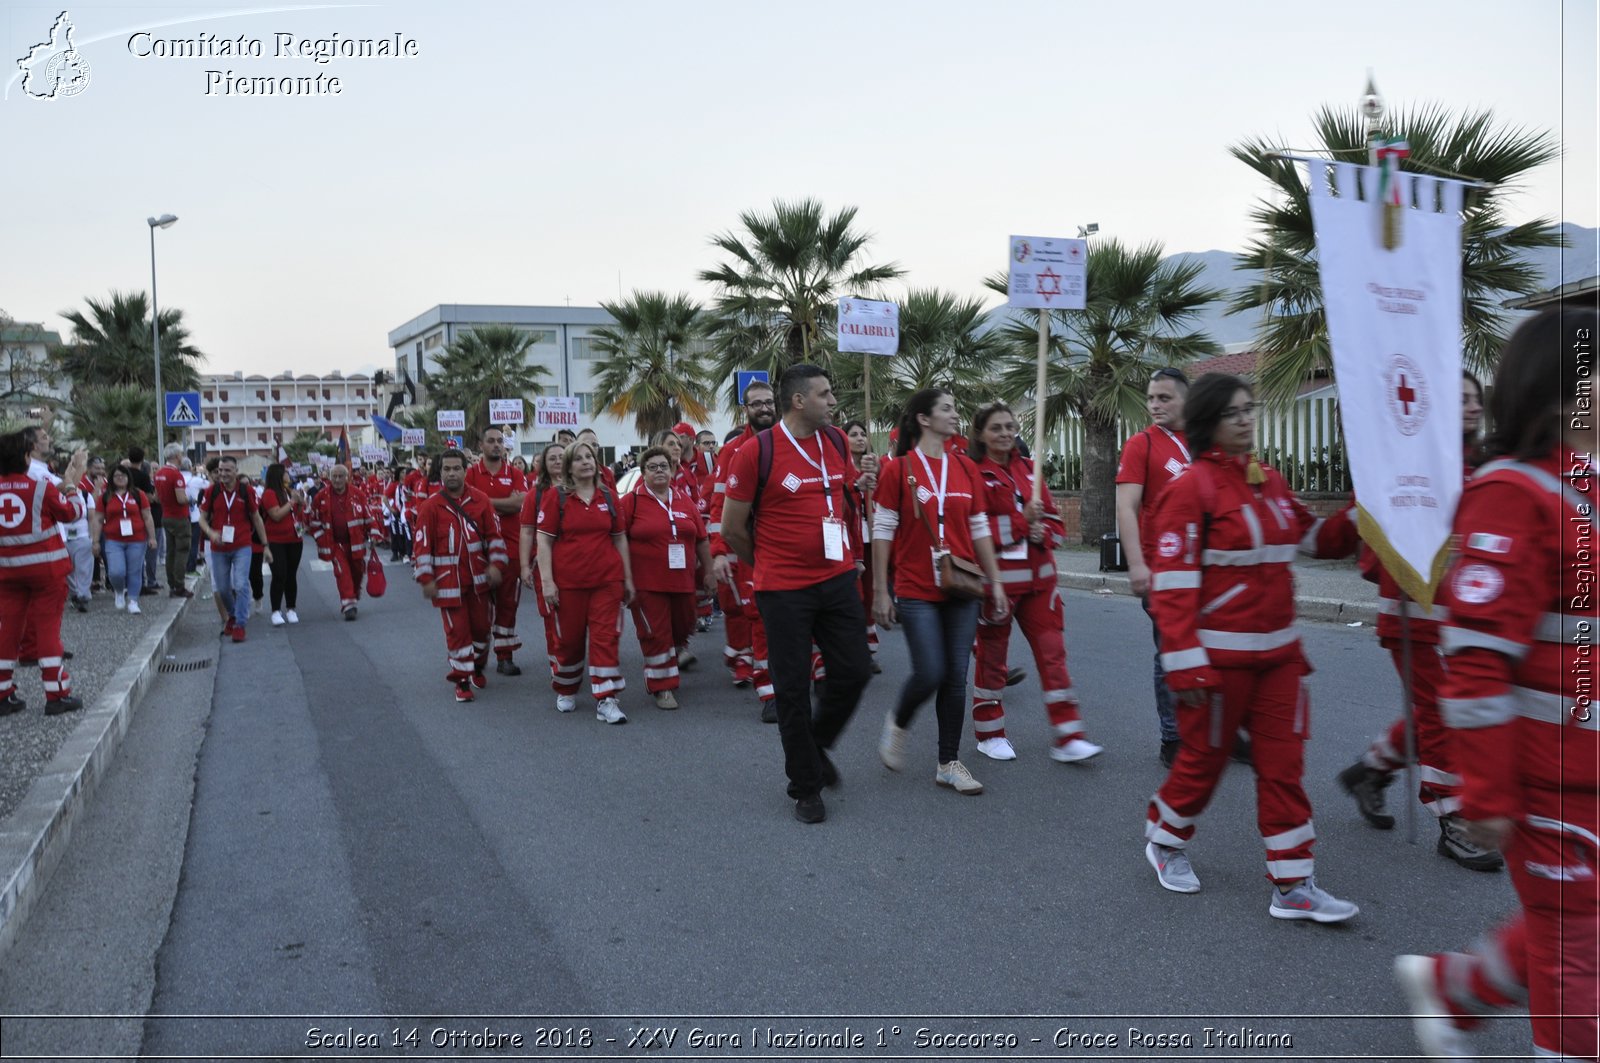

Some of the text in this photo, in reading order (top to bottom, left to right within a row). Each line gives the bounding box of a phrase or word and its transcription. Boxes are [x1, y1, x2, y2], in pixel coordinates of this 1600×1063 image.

[841, 323, 895, 337] CALABRIA
[492, 410, 522, 421] ABRUZZO
[538, 411, 577, 425] UMBRIA
